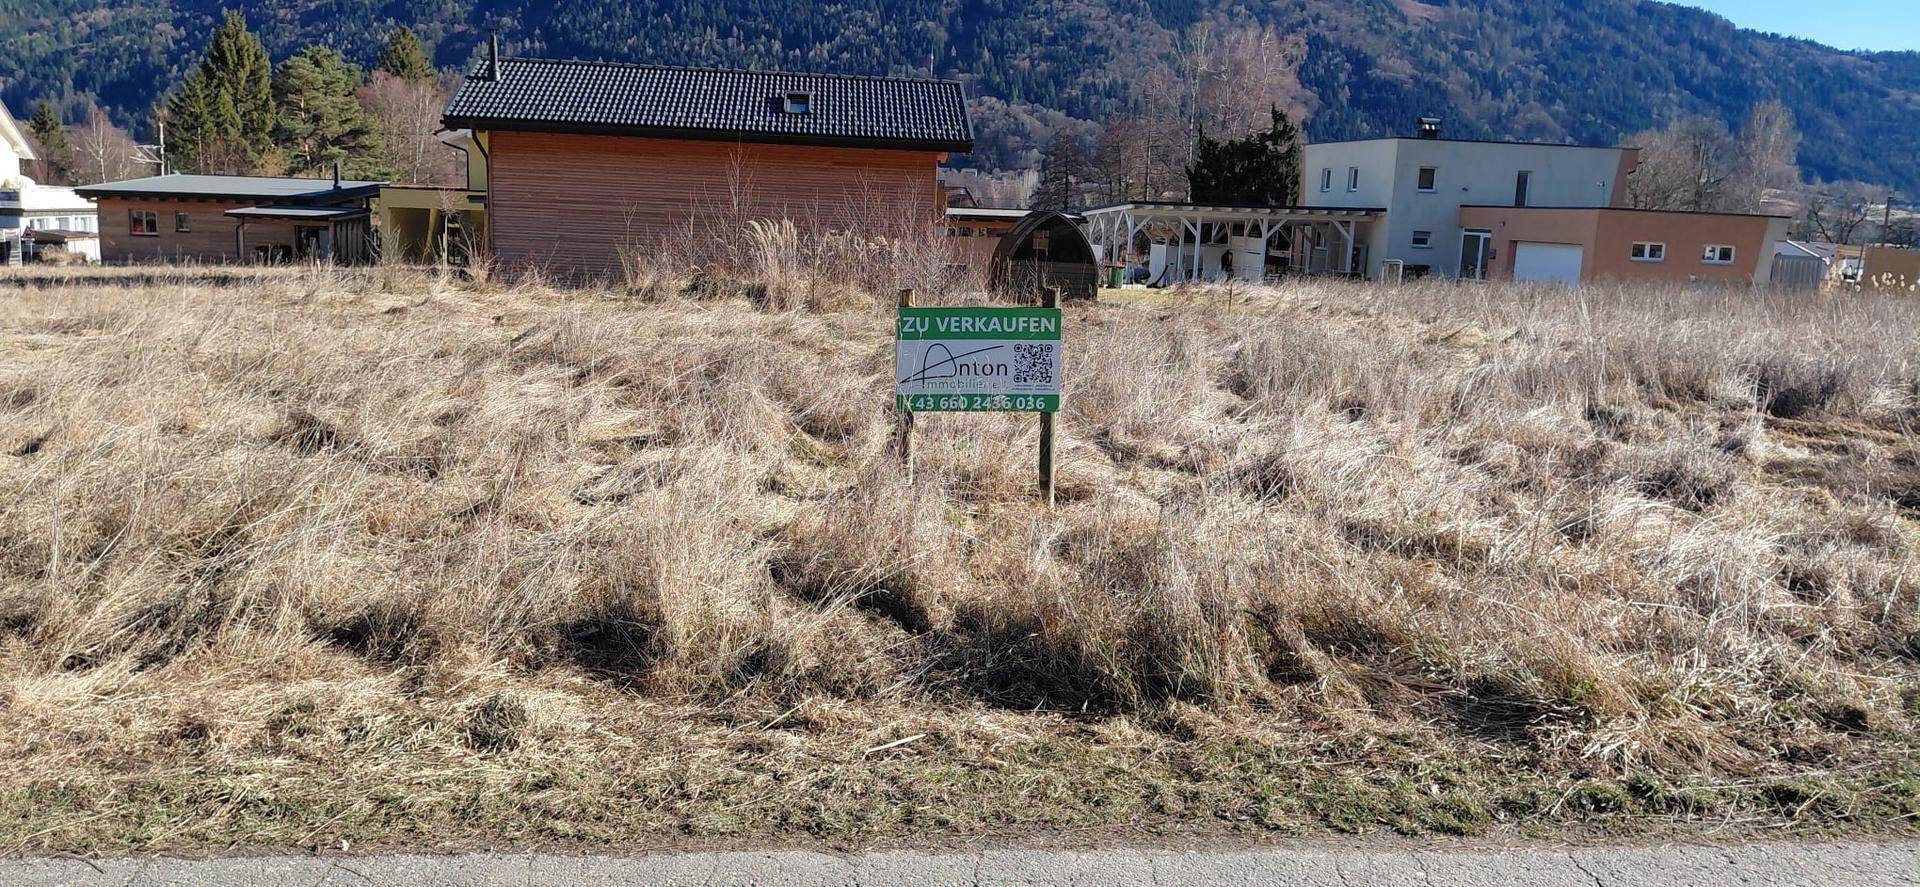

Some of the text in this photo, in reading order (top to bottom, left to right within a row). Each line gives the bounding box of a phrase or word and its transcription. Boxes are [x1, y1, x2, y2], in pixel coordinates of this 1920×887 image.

[902, 316, 1055, 333] ZU VERKAUFEN
[900, 343, 1008, 386] Anton
[940, 396, 968, 409] 660
[1016, 396, 1046, 410] 036
